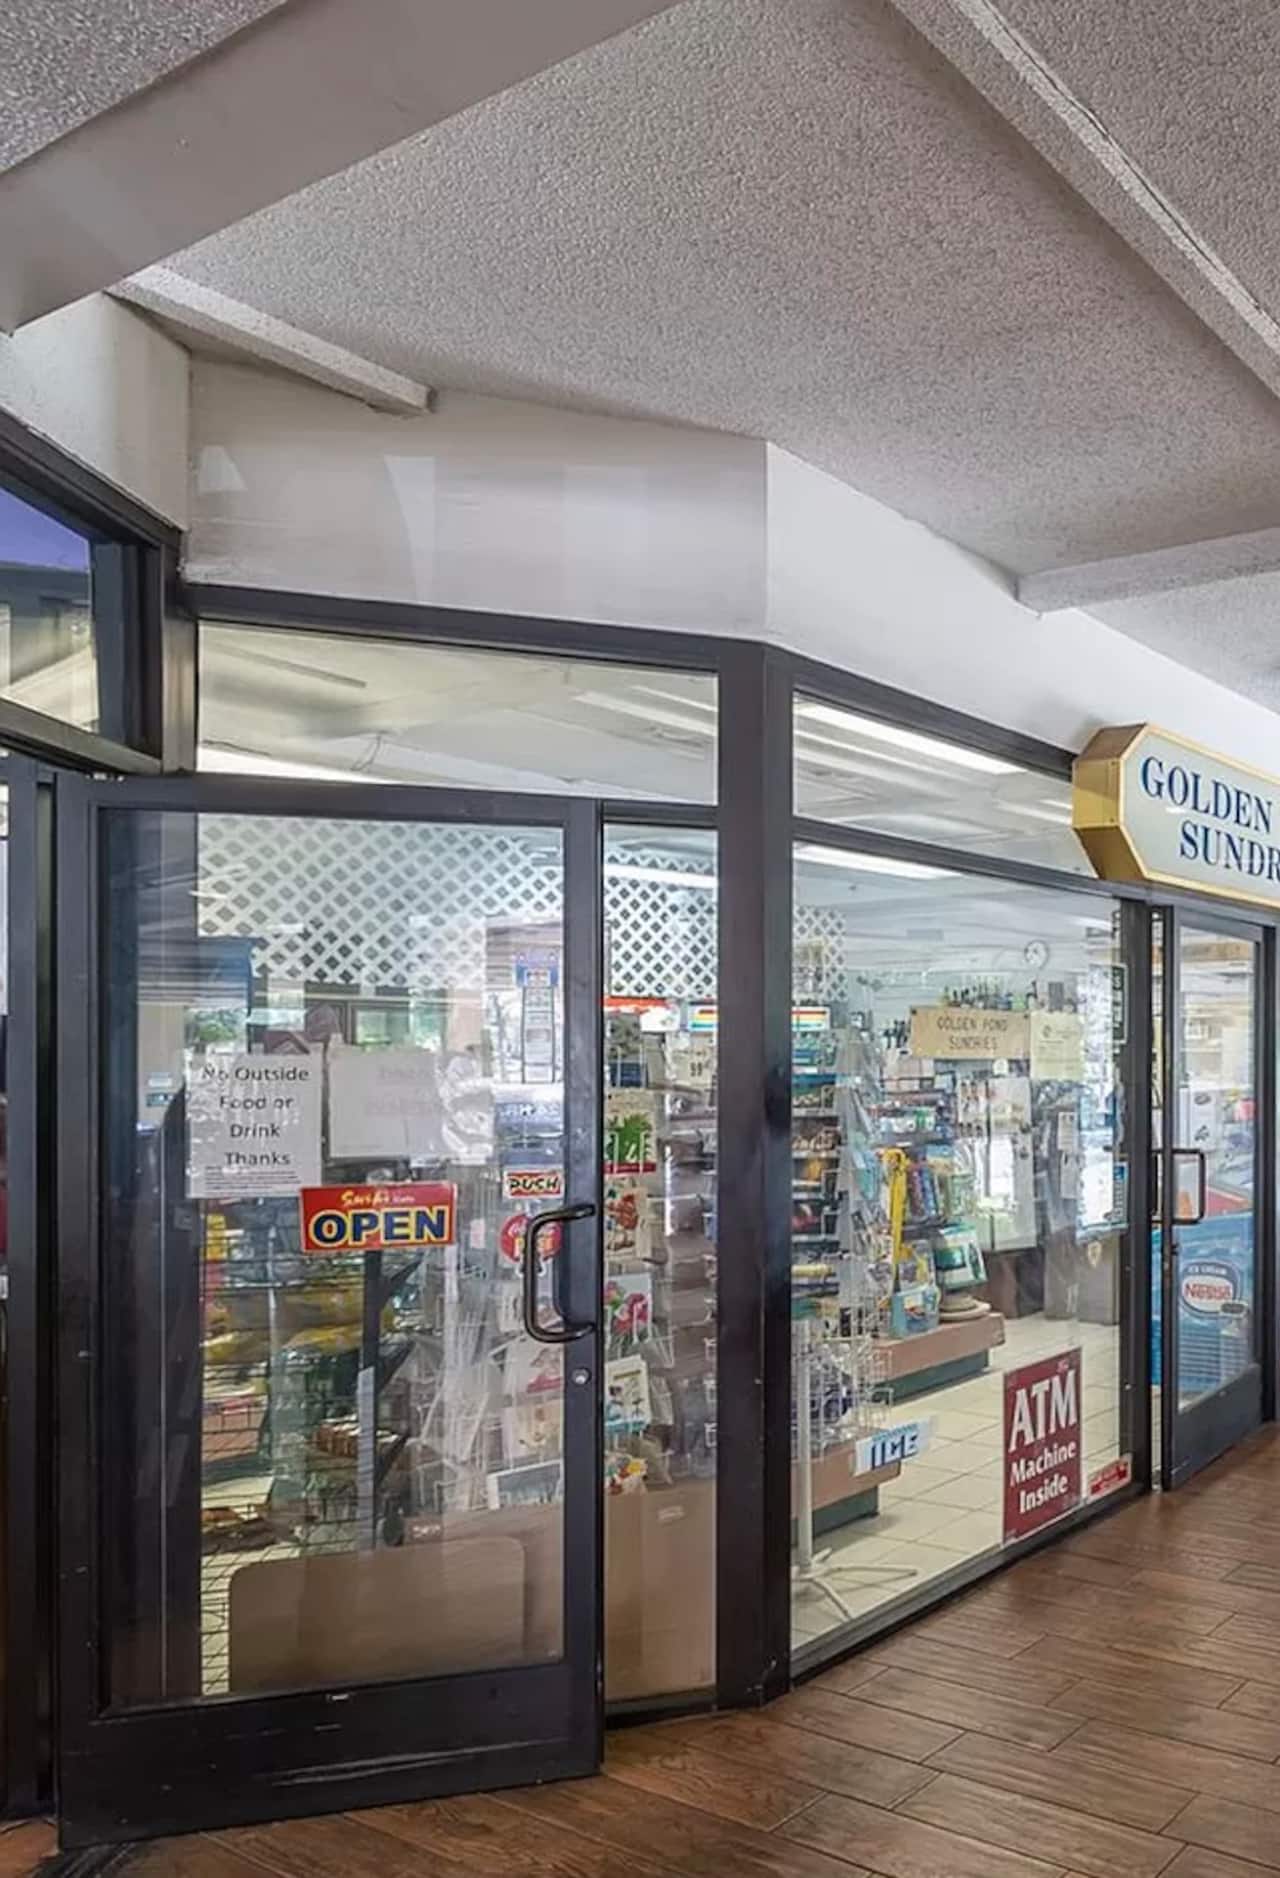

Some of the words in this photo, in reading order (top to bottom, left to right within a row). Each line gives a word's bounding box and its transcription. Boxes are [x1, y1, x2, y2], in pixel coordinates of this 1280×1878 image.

[1141, 756, 1273, 834] GOLDEN
[936, 1015, 978, 1031] GOLDEN
[202, 1065, 229, 1081] No
[234, 1066, 310, 1082] Outside
[219, 1095, 267, 1111] Food
[273, 1098, 295, 1111] or
[229, 1123, 281, 1138] Drink
[224, 1151, 291, 1166] Thanks
[311, 1208, 448, 1246] OPEN
[1008, 1368, 1078, 1453] ATM
[1010, 1440, 1077, 1487] Machine
[1019, 1473, 1069, 1514] Inside
